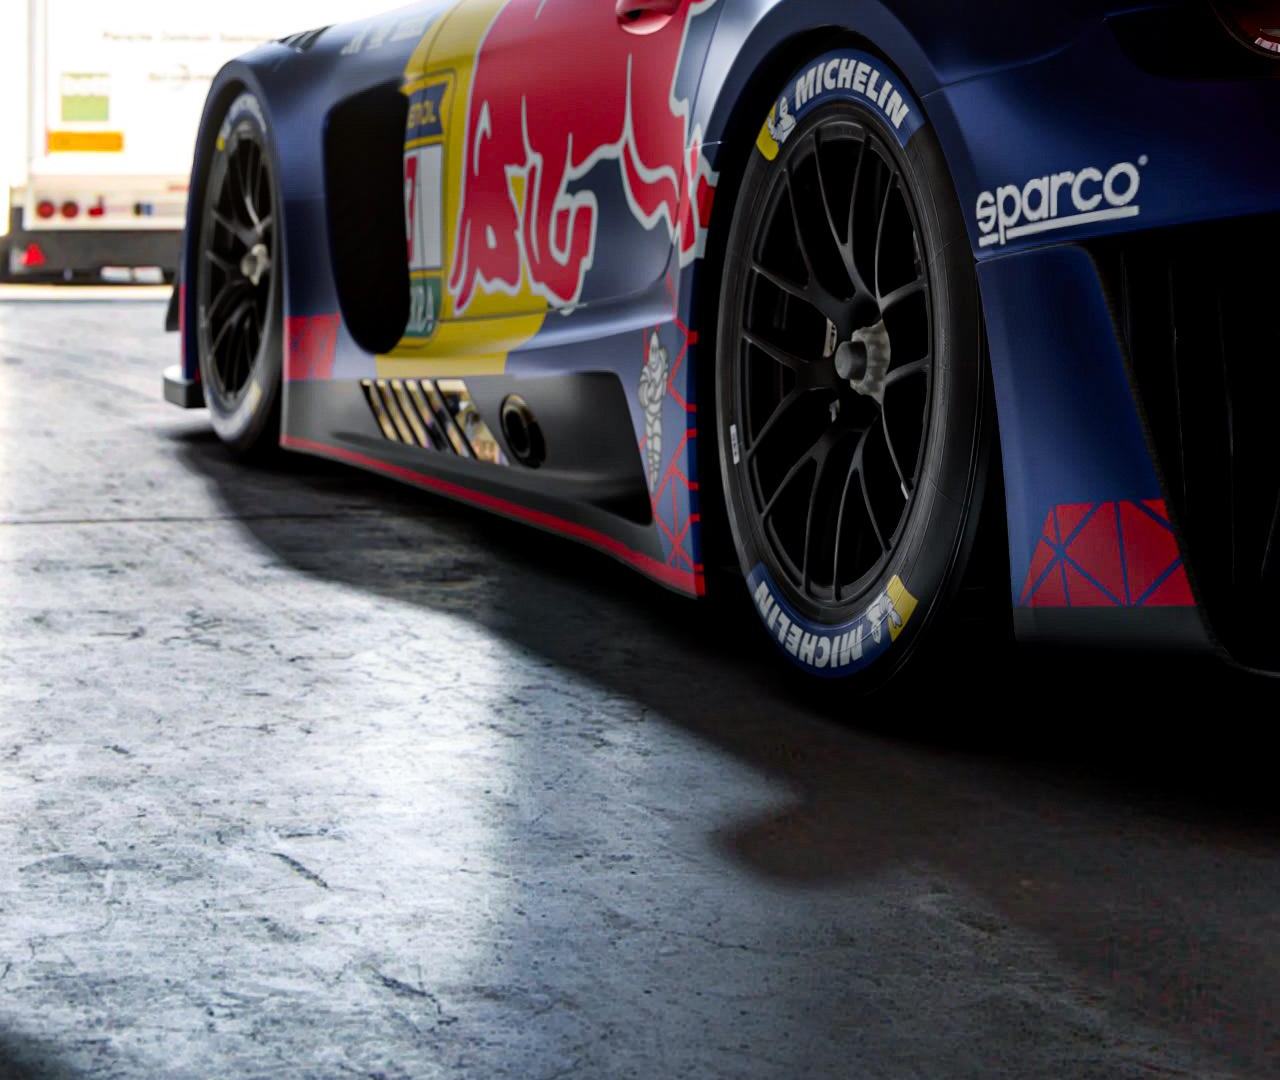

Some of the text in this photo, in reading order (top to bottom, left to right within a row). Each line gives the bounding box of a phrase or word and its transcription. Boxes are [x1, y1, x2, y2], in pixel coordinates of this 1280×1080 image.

[794, 58, 910, 129] MICHELIN
[975, 161, 1141, 247] sparco
[754, 581, 863, 669] MICHELIN
